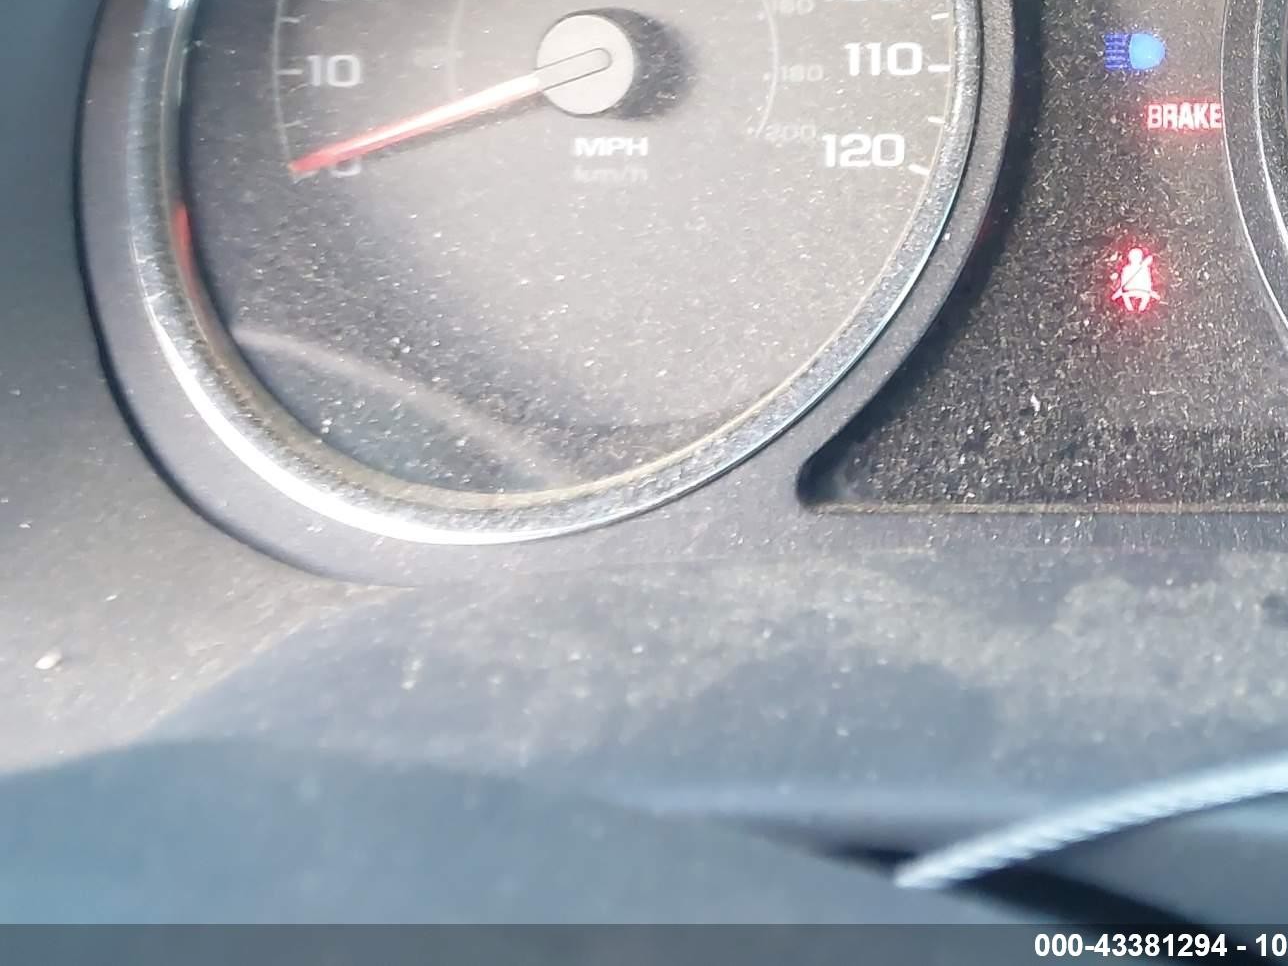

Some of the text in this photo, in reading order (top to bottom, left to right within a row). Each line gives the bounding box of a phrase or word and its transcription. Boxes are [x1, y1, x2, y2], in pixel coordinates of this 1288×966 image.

[307, 54, 361, 88] 10
[845, 42, 923, 75] 110
[1147, 102, 1224, 130] BRAKE
[575, 137, 648, 156] MPH
[821, 134, 905, 167] 120
